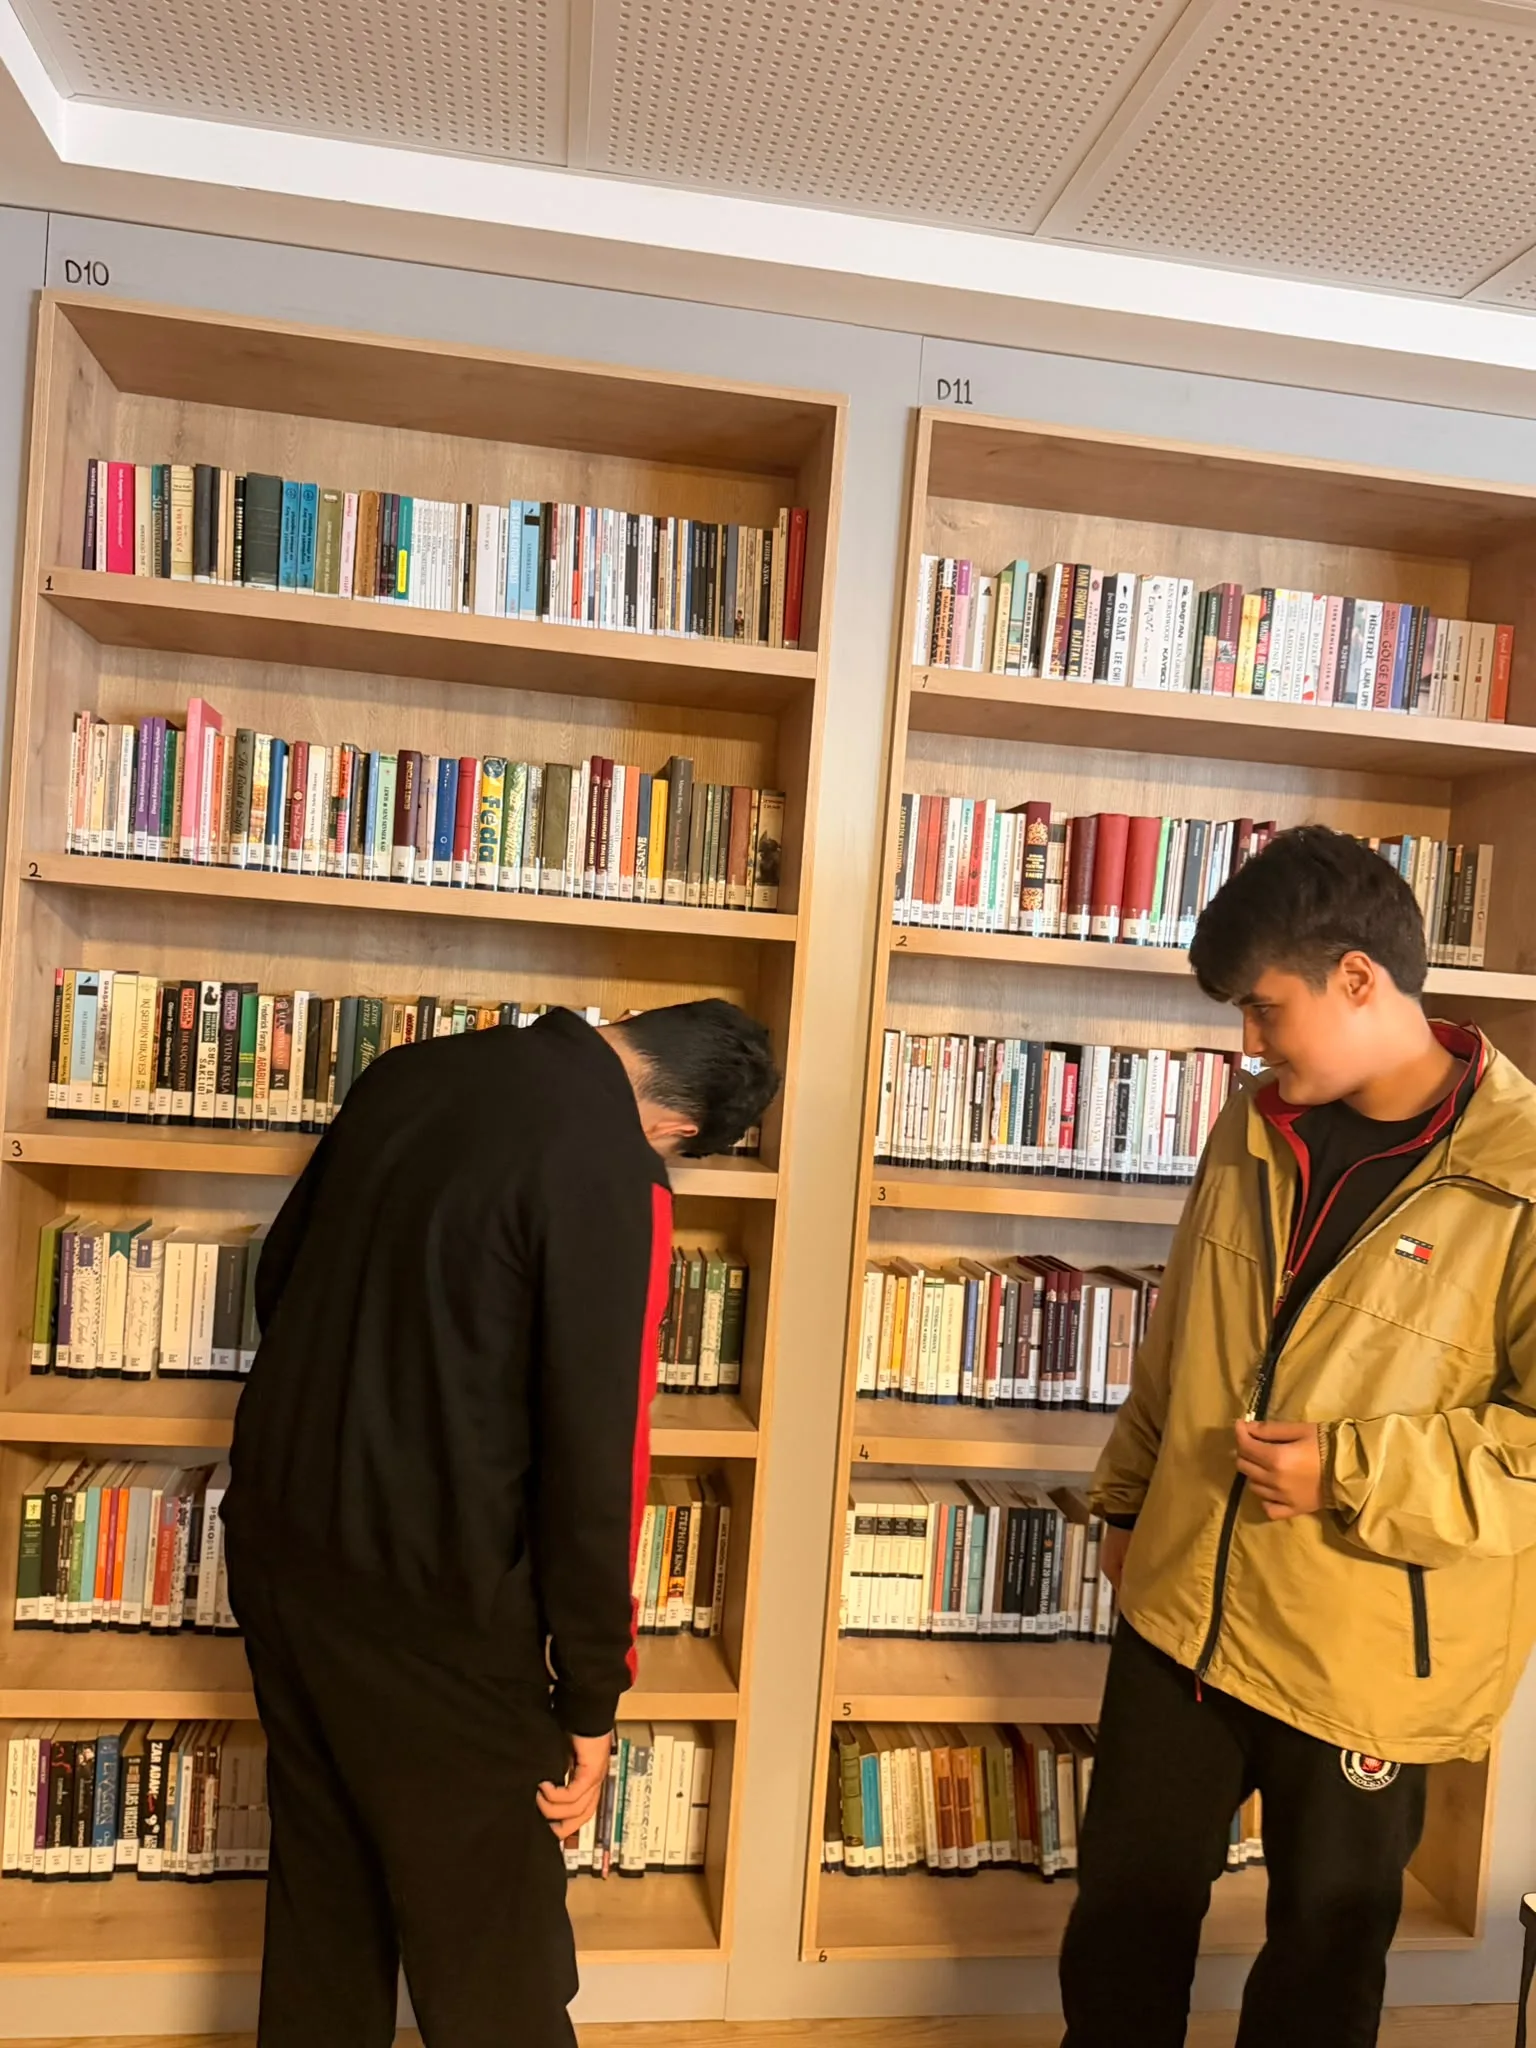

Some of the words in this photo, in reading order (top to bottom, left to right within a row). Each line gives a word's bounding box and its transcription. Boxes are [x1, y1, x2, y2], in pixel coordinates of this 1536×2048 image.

[65, 260, 109, 286] D10
[937, 378, 973, 404] D11
[45, 577, 53, 590] 1
[1118, 602, 1127, 614] 61
[1115, 616, 1127, 641] SAAT
[922, 675, 929, 688] 1
[28, 863, 42, 877] 2
[896, 936, 907, 947] 2
[12, 1140, 23, 1157] 3
[878, 1187, 886, 1201] 3
[859, 1445, 869, 1459] 4
[842, 1702, 852, 1716] 5
[150, 1741, 162, 1763] ZAR
[147, 1764, 161, 1794] ADAM
[818, 1950, 827, 1962] 6
